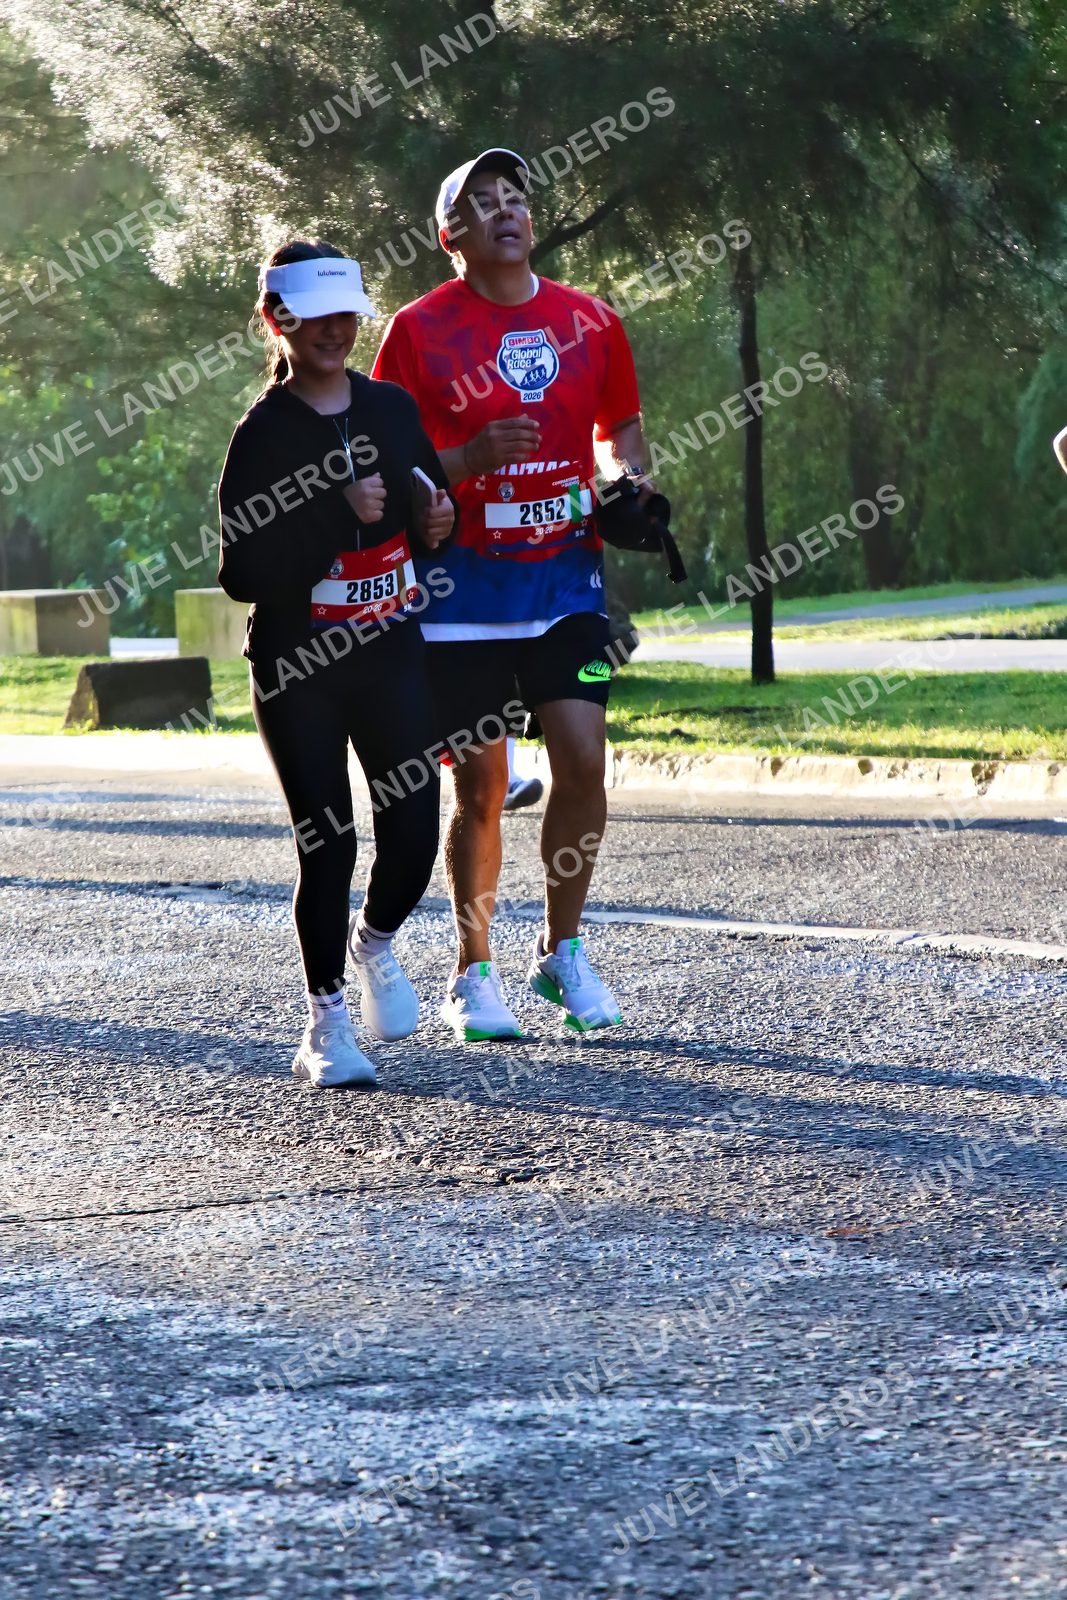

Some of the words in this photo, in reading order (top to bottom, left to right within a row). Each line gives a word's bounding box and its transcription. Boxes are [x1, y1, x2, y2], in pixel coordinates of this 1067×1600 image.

[508, 336, 540, 346] BIMBO
[511, 347, 541, 360] Global
[507, 358, 532, 370] Race
[523, 392, 542, 401] 2026
[520, 498, 565, 525] 2852
[346, 572, 394, 604] 2853
